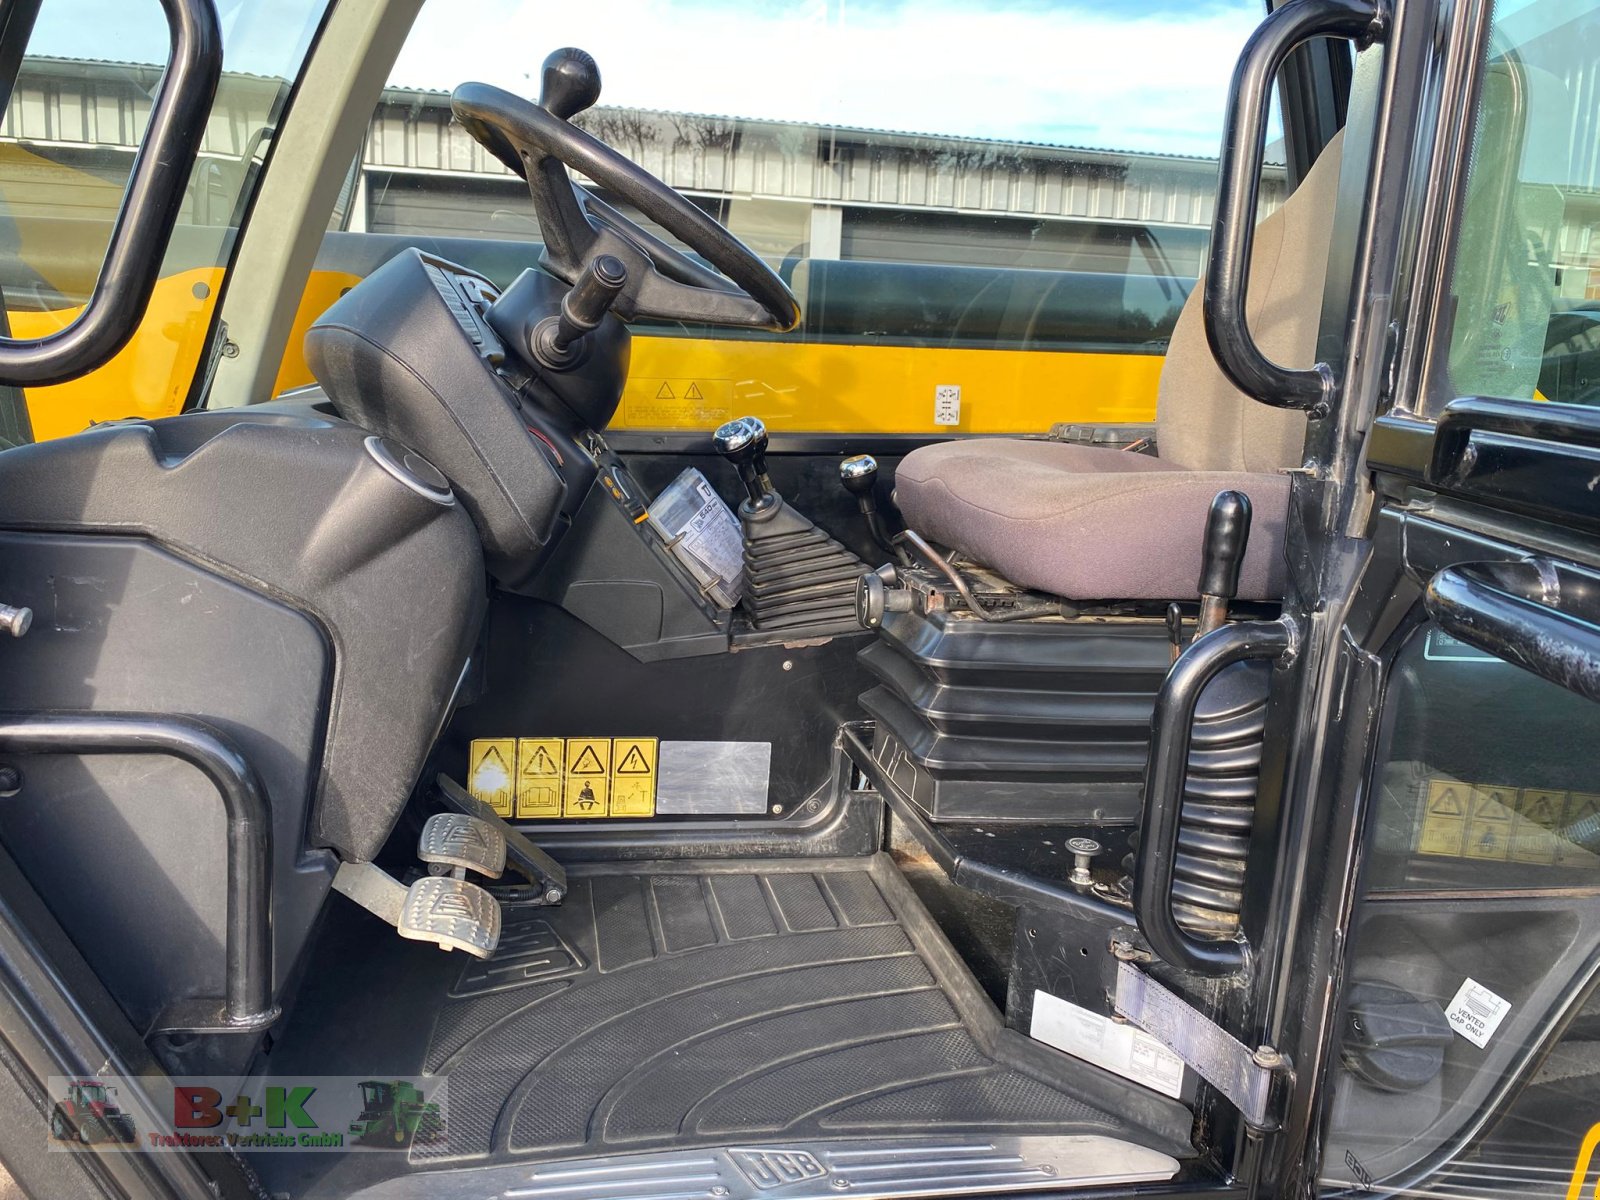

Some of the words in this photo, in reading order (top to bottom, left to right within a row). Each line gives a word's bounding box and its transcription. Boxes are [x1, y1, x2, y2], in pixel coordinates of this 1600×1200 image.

[1450, 1013, 1465, 1025] CAP
[1465, 1023, 1485, 1038] ONLY
[1458, 1008, 1485, 1029] VENTED
[738, 1151, 825, 1188] JCB
